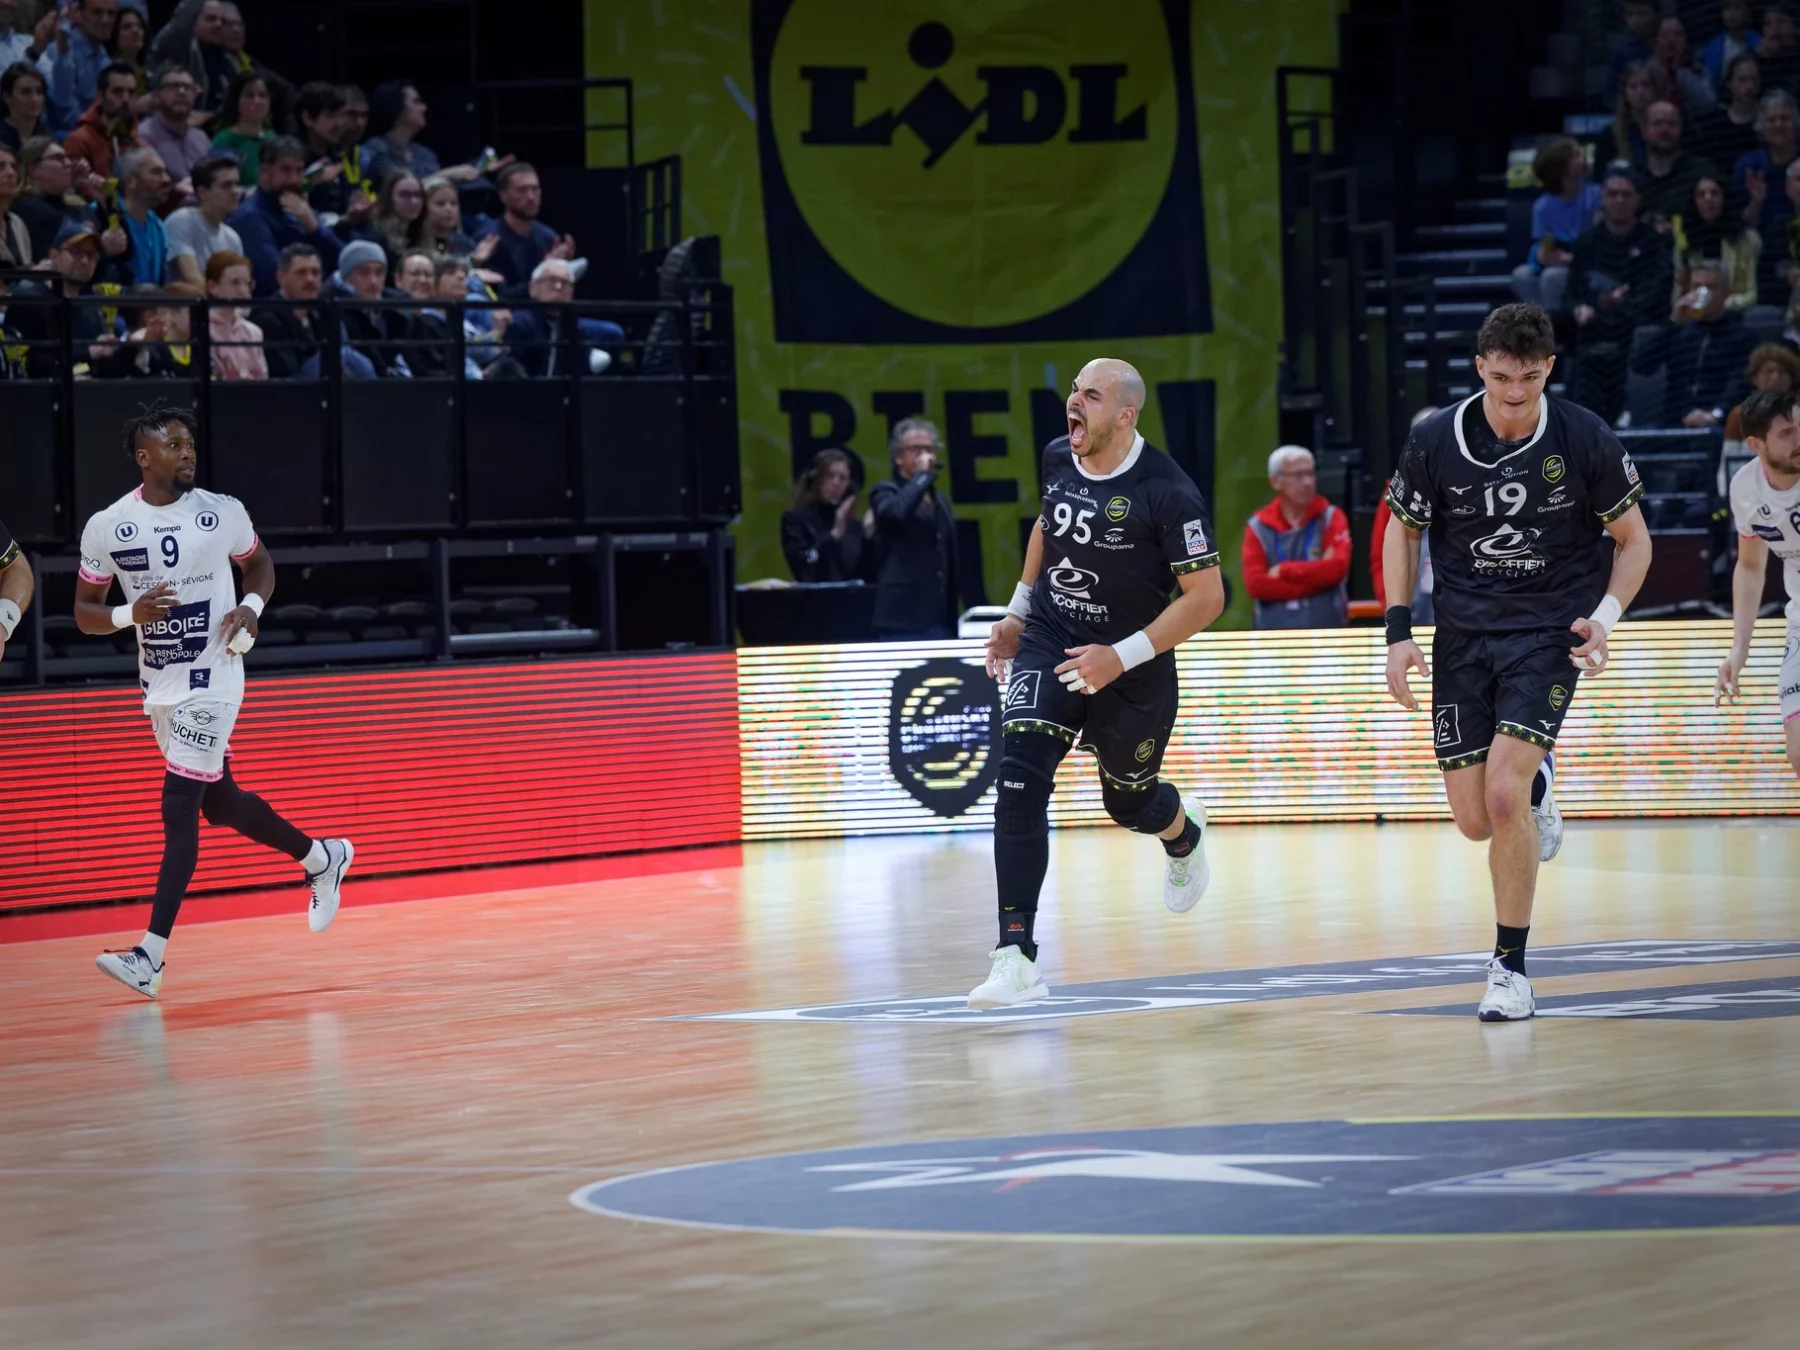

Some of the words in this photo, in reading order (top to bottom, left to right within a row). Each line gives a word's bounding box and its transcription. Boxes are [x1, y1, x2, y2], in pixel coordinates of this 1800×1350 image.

[1484, 482, 1527, 516] 19
[200, 516, 213, 527] U
[1053, 502, 1096, 544] 95
[120, 526, 133, 538] U
[154, 525, 182, 534] Kempa
[1094, 540, 1135, 551] Groupama
[161, 535, 180, 568] 9
[1003, 780, 1025, 789] SELECT
